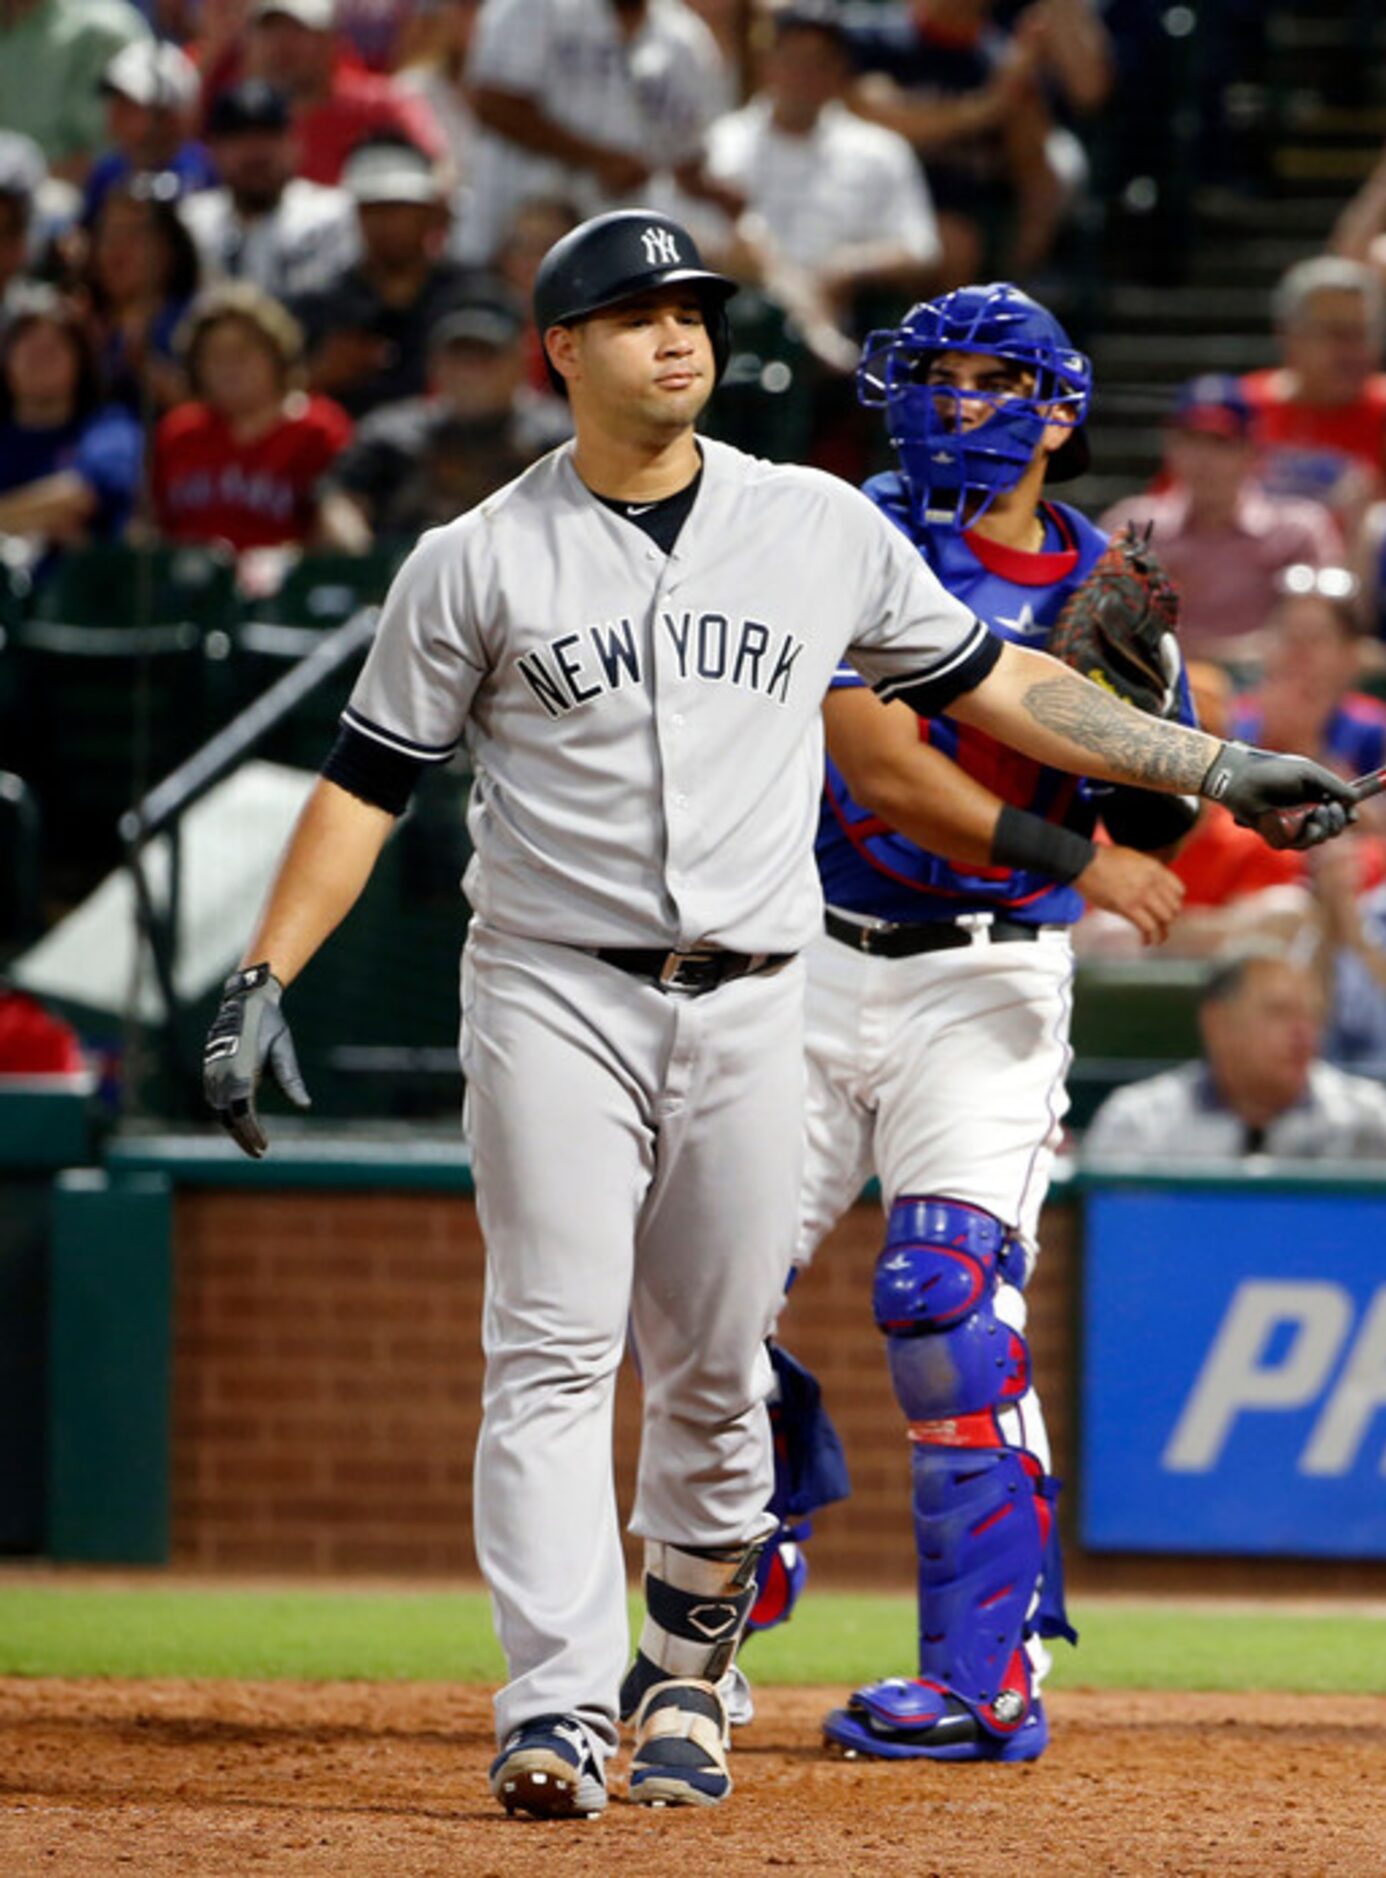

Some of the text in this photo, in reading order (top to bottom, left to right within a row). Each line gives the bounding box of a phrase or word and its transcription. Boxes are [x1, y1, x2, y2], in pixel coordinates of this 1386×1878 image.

[641, 227, 681, 265] NY
[516, 611, 805, 719] NEW YORK
